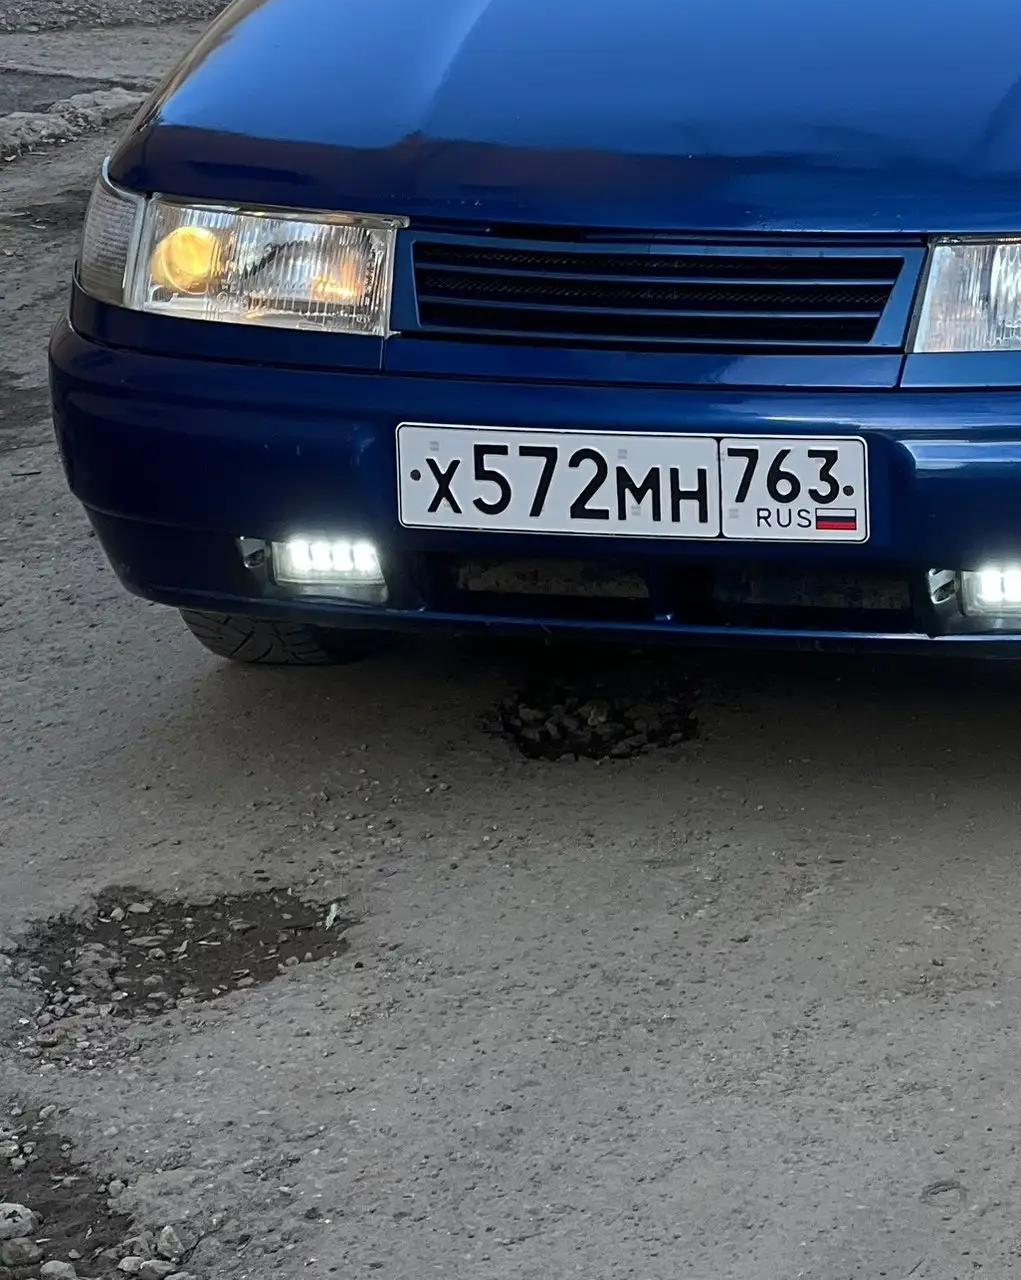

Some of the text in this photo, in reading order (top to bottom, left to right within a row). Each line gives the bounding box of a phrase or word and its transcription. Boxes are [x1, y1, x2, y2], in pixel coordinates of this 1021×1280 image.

[424, 443, 840, 524] Х572МН 763
[756, 508, 813, 529] RUS
